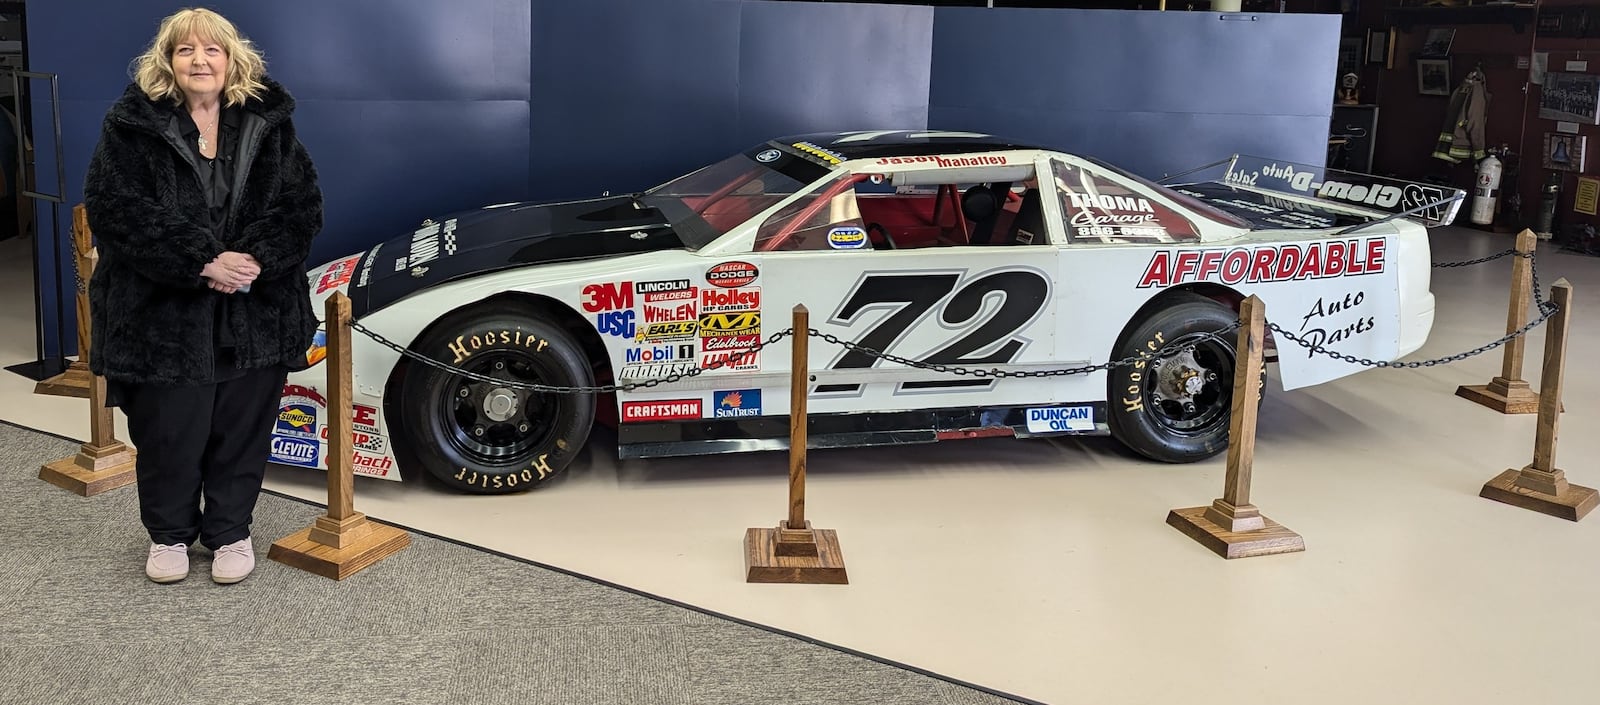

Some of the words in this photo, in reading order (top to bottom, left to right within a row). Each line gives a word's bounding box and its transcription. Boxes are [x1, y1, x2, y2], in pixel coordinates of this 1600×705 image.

[876, 154, 940, 165] Jason
[1066, 193, 1155, 213] THOMA
[1071, 211, 1160, 225] Garage
[1136, 237, 1386, 288] AFFORDABLE
[710, 270, 754, 279] DODGE
[638, 281, 688, 293] LINCOLN
[650, 291, 692, 300] WELDERS
[582, 281, 633, 312] 3M
[702, 289, 759, 309] Holley
[644, 301, 697, 323] WHELEN
[1300, 291, 1364, 331] Auto
[597, 309, 635, 338] USG
[648, 322, 695, 335] EARL'S
[700, 329, 738, 337] MECHANIX
[739, 327, 760, 336] WEAR
[809, 265, 1053, 398] 72
[448, 326, 549, 364] Hoosier
[706, 337, 756, 349] Edelbrock
[1299, 316, 1374, 359] Parts
[626, 345, 673, 362] Mobil
[1123, 331, 1164, 413] Hoosier
[281, 413, 313, 423] SUNOCO
[627, 403, 698, 417] CRAFTSMAN
[716, 407, 759, 417] SUNTRUST
[1031, 407, 1089, 421] DUNCAN
[1050, 420, 1073, 431] OIL
[271, 437, 314, 458] CLEVITE
[454, 453, 553, 488] Hoosier
